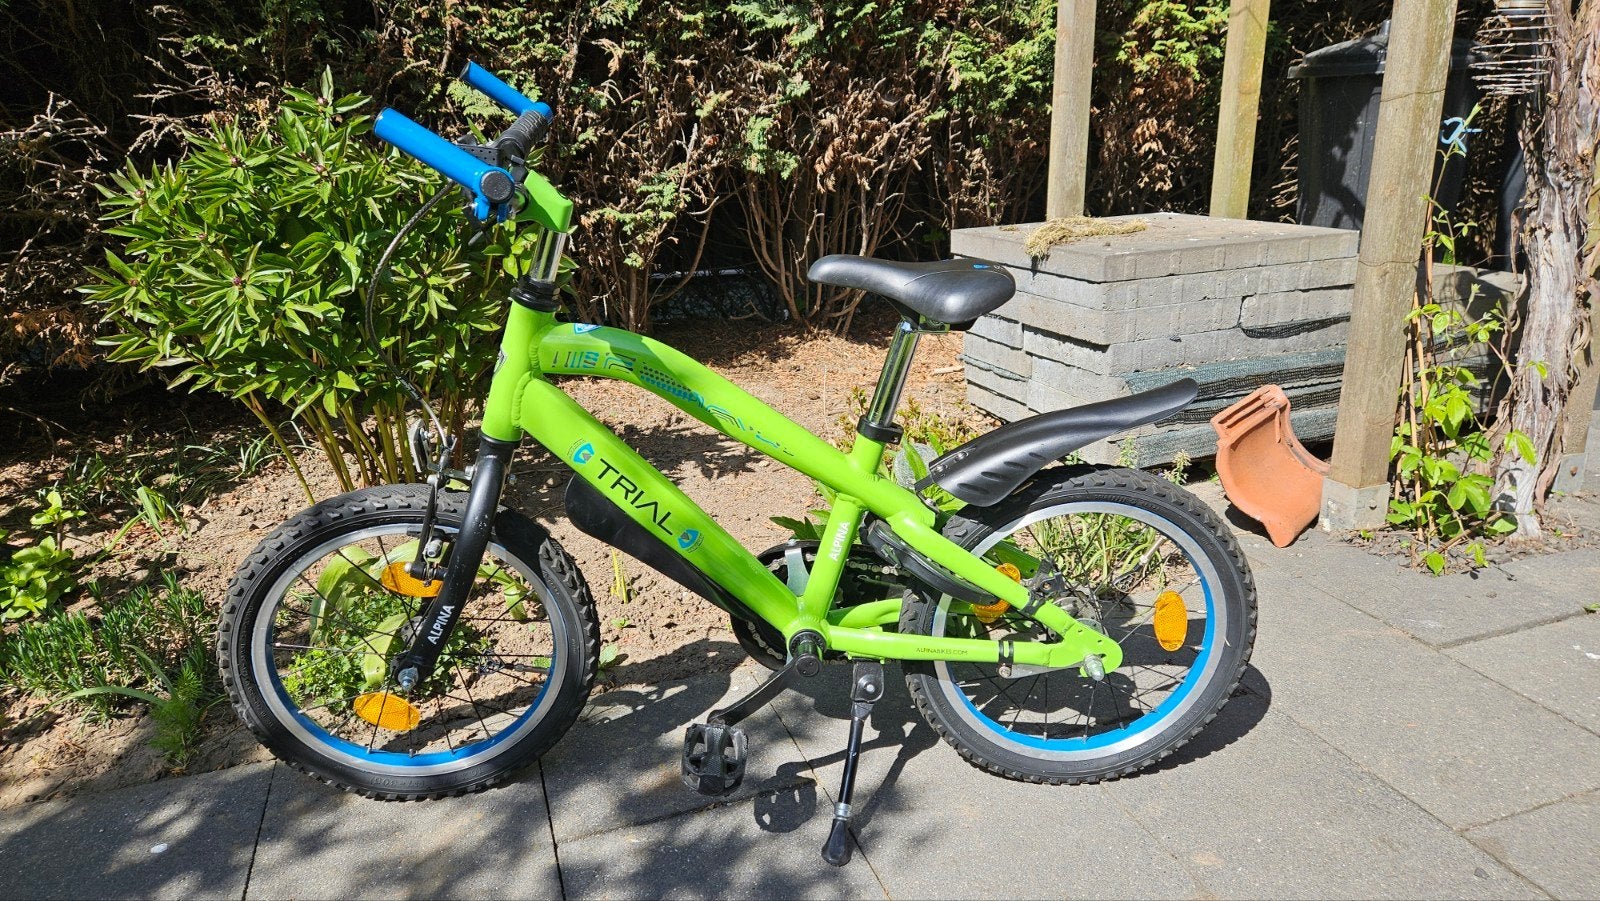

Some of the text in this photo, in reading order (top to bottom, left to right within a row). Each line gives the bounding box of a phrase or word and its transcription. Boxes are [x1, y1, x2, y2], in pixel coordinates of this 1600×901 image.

[598, 458, 673, 536] TRIAL
[829, 521, 850, 561] ALPINA
[427, 605, 455, 645] ALPINA
[916, 647, 968, 655] ALPINABIKES.COM
